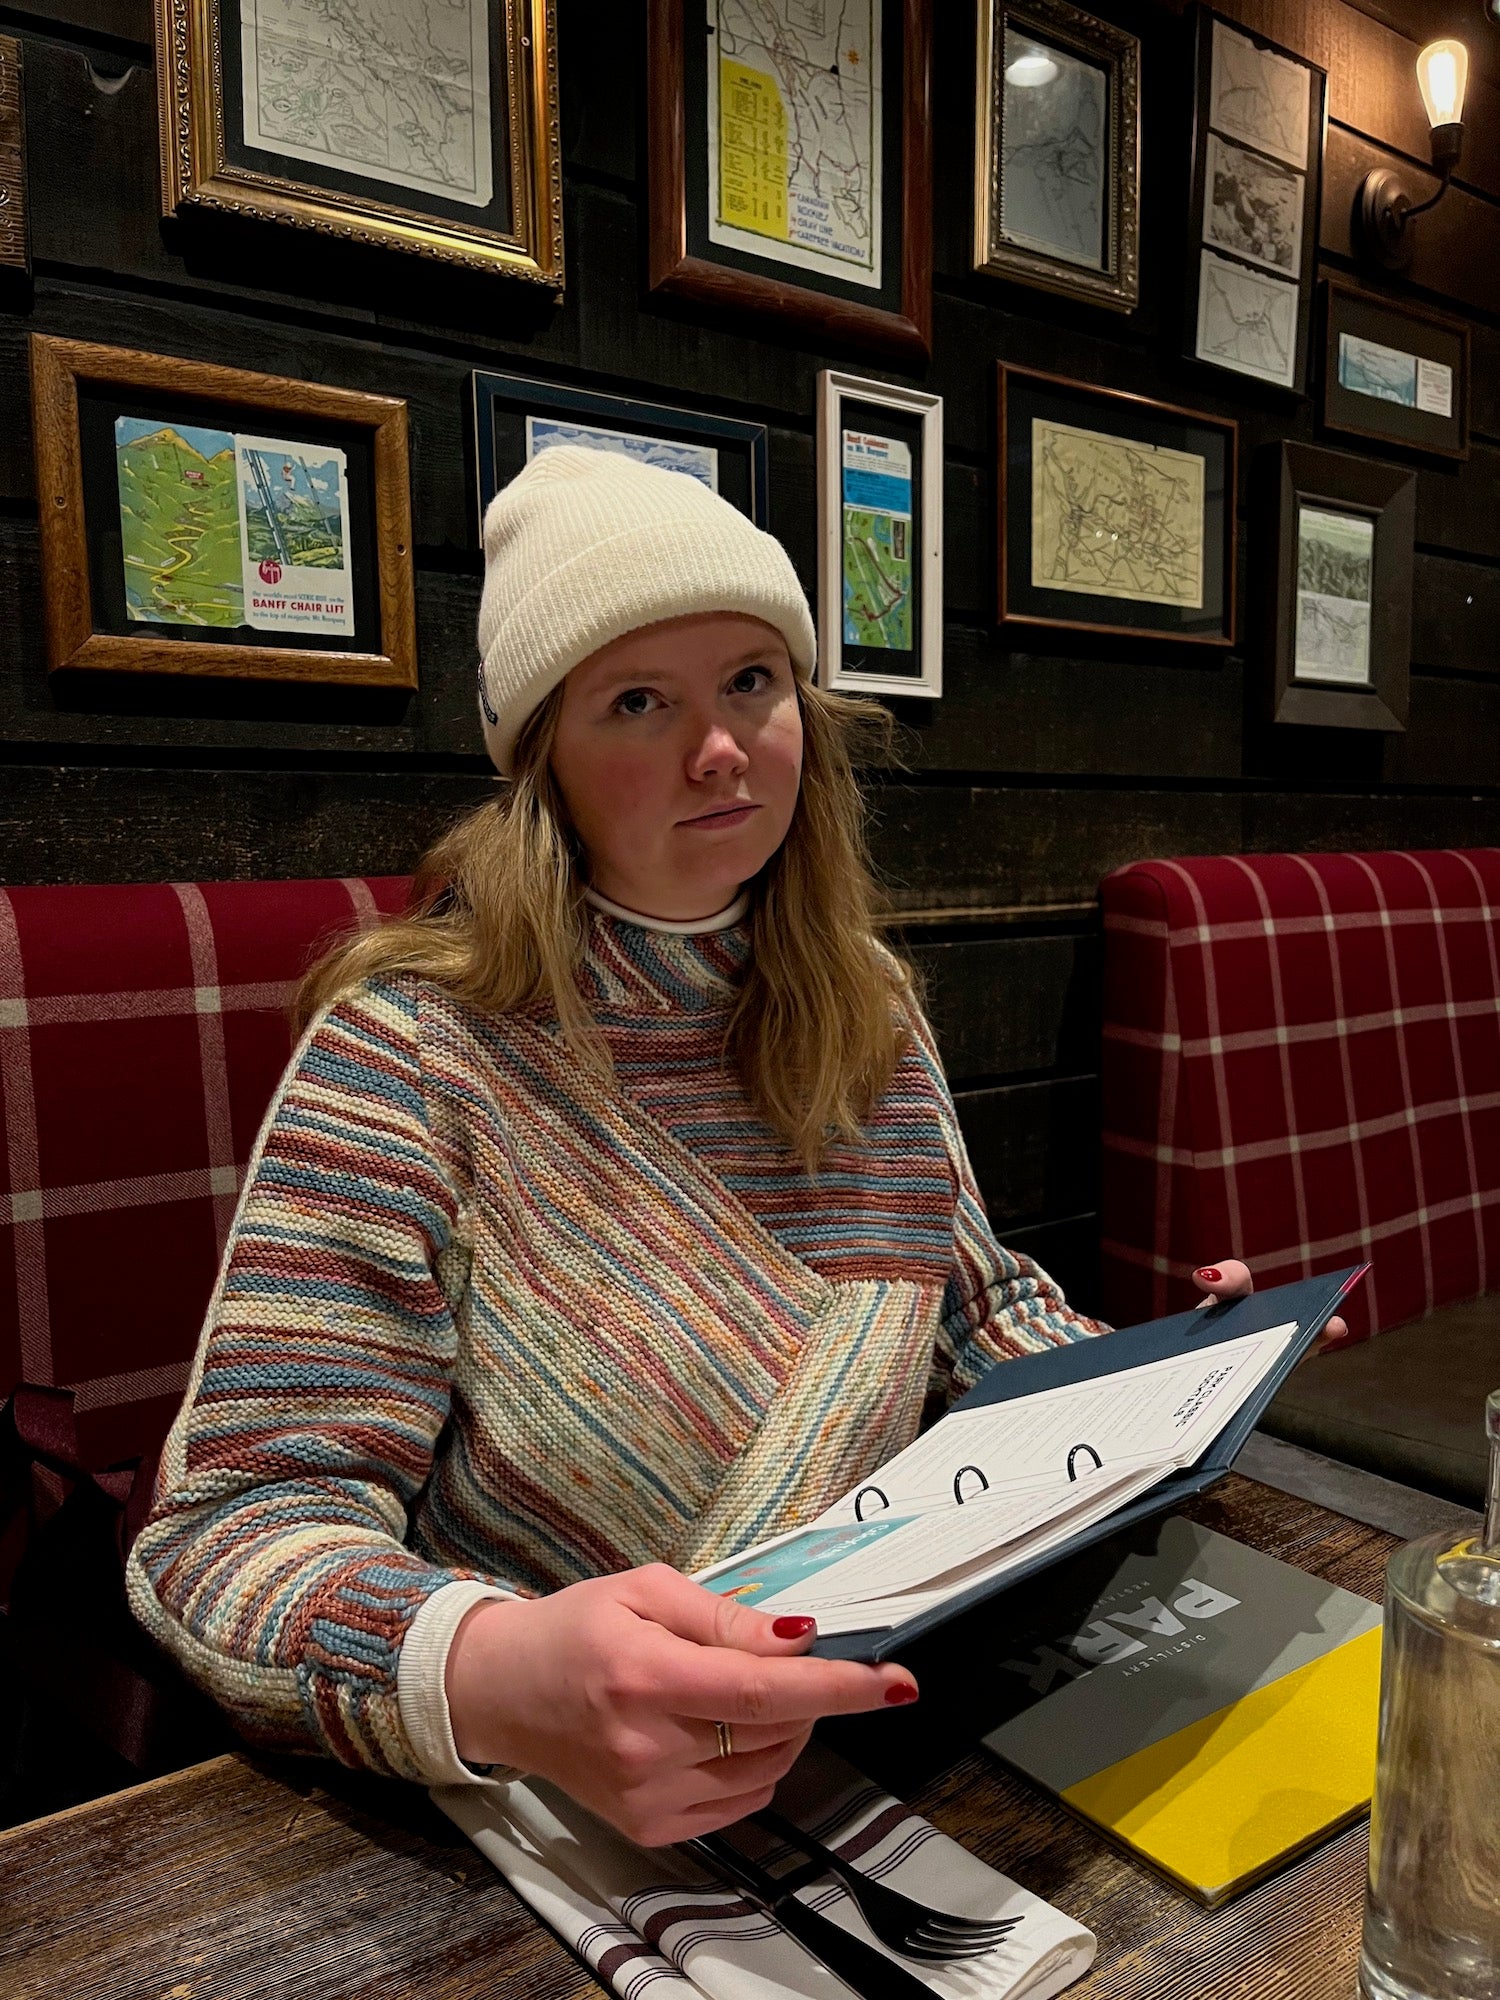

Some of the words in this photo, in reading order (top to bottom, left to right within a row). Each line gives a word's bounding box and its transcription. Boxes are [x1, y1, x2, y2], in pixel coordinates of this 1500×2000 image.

[252, 598, 287, 610] BANFF
[290, 601, 322, 613] CHAIR
[325, 604, 345, 614] LIFT
[996, 1577, 1243, 1694] PARK
[1122, 1634, 1207, 1678] DISTILLERY
